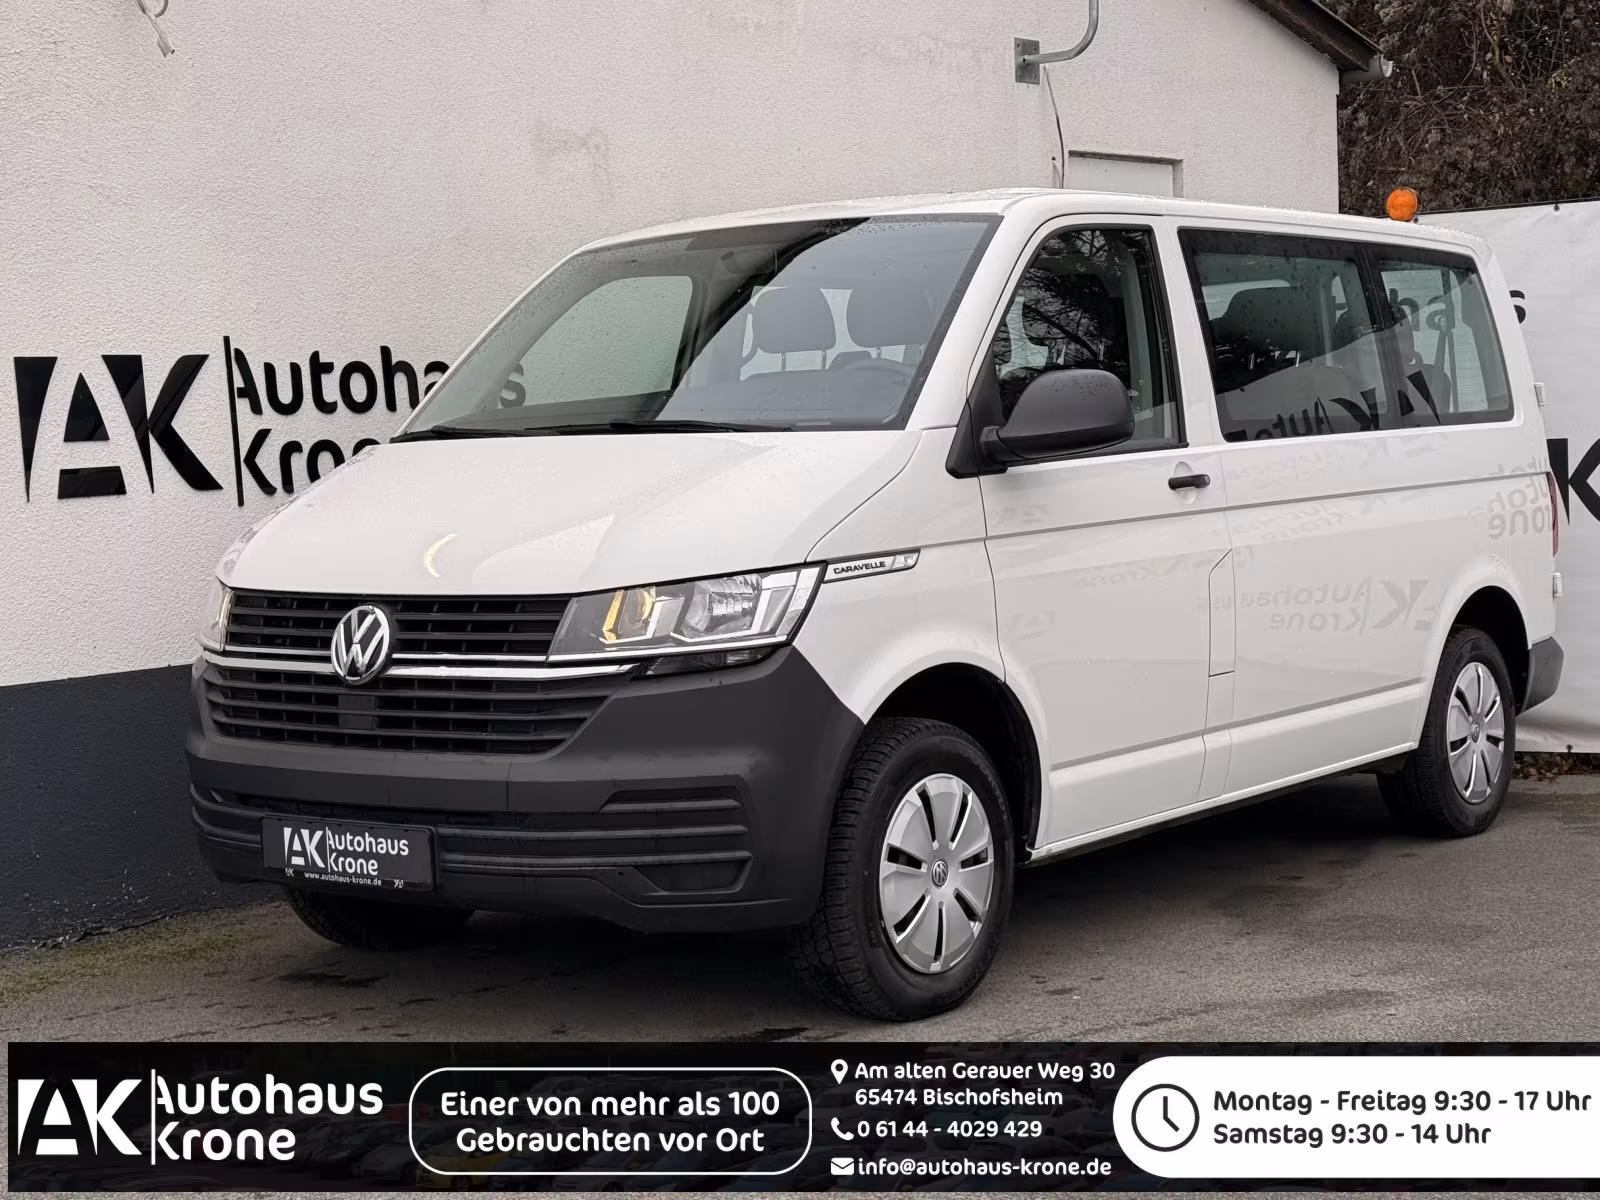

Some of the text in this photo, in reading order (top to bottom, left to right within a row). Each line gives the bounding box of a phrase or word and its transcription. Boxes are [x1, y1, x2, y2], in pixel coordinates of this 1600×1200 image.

[13, 353, 224, 502] AK
[243, 428, 381, 496] Kro
[833, 561, 886, 574] CARAVELLE
[331, 605, 390, 681] VW
[283, 827, 326, 868] AK
[327, 829, 409, 856] Autohaus
[304, 871, 382, 886] www.autohaus-krone.de
[328, 852, 379, 876] Krone
